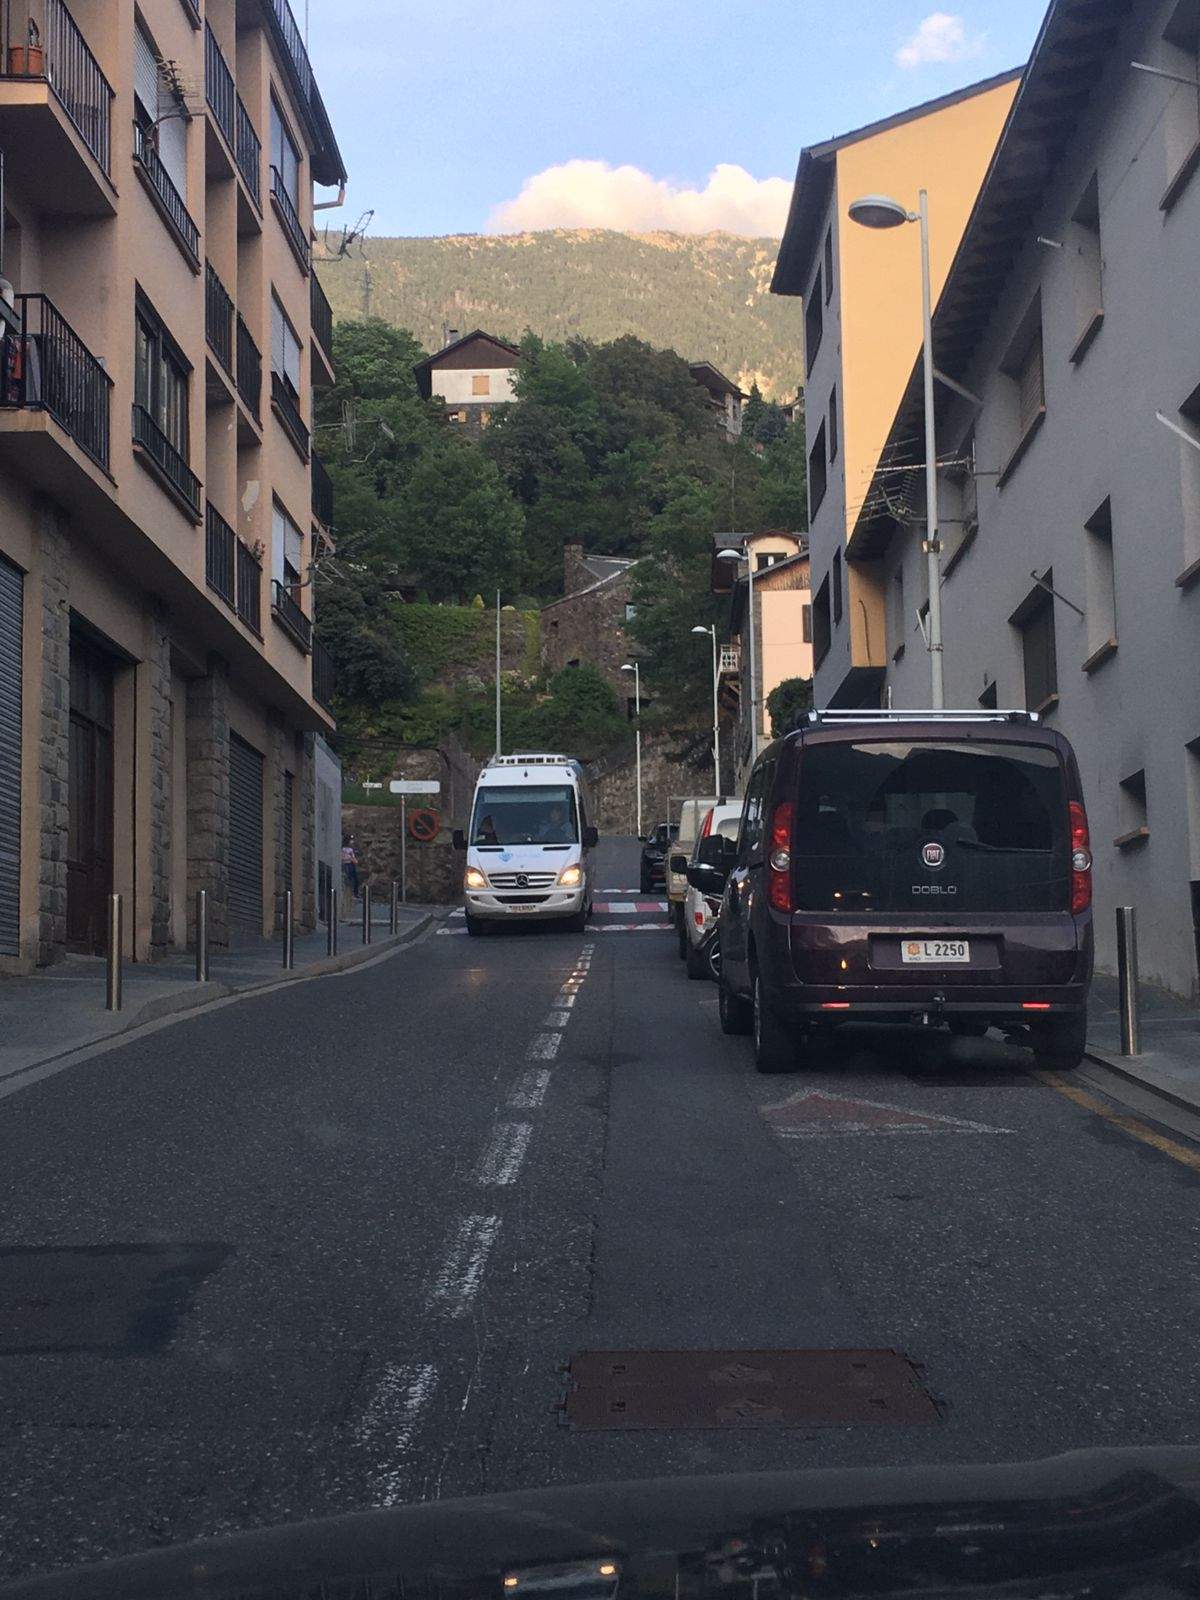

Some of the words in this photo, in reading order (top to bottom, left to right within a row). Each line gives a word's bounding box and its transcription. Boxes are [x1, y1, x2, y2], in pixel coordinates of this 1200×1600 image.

[911, 885, 957, 894] DOBLO
[924, 943, 932, 956] L
[934, 943, 965, 956] 2250
